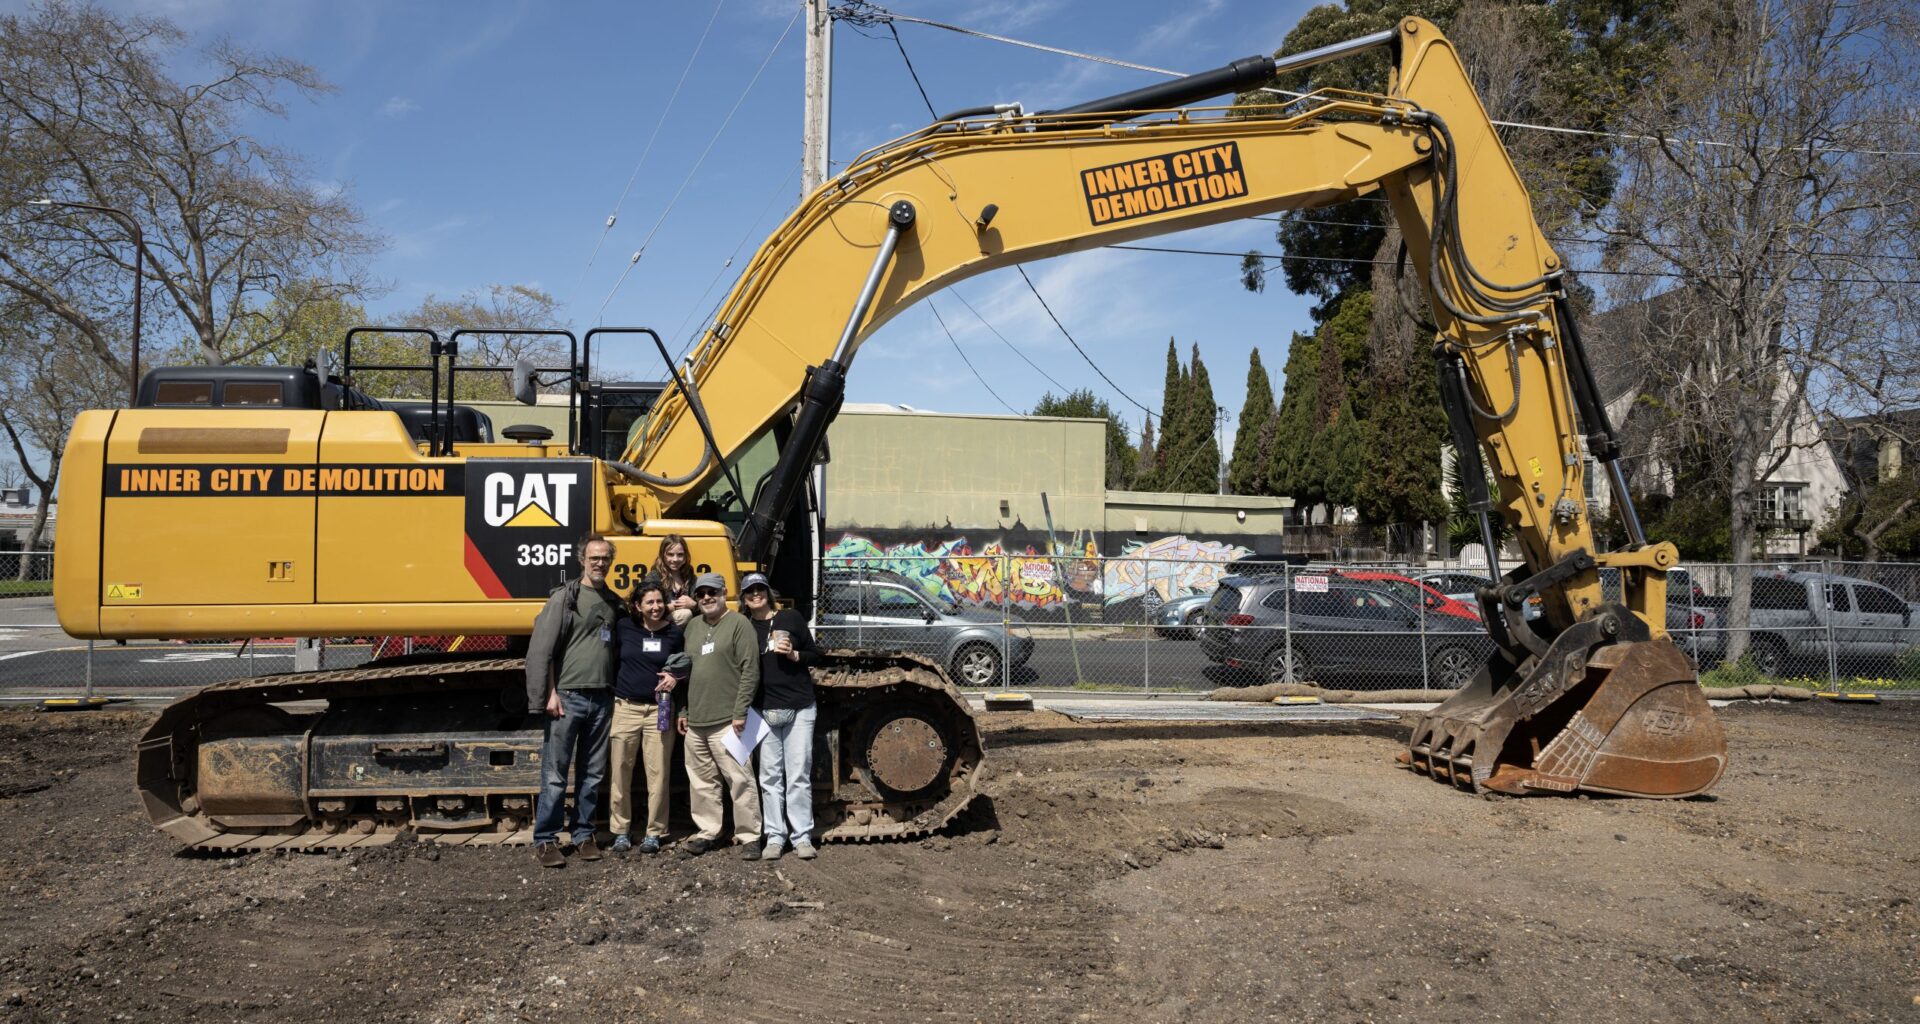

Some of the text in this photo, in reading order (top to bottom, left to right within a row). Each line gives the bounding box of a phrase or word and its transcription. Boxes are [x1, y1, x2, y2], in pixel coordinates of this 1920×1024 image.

[1084, 144, 1234, 196] INNER CITY
[1091, 170, 1244, 223] DEMOLITION
[120, 468, 445, 492] INNER CITY DEMOLITION
[484, 472, 578, 527] CAT
[517, 543, 572, 566] 336F
[1023, 562, 1052, 572] NATIONAL
[1295, 575, 1328, 585] NATIONAL
